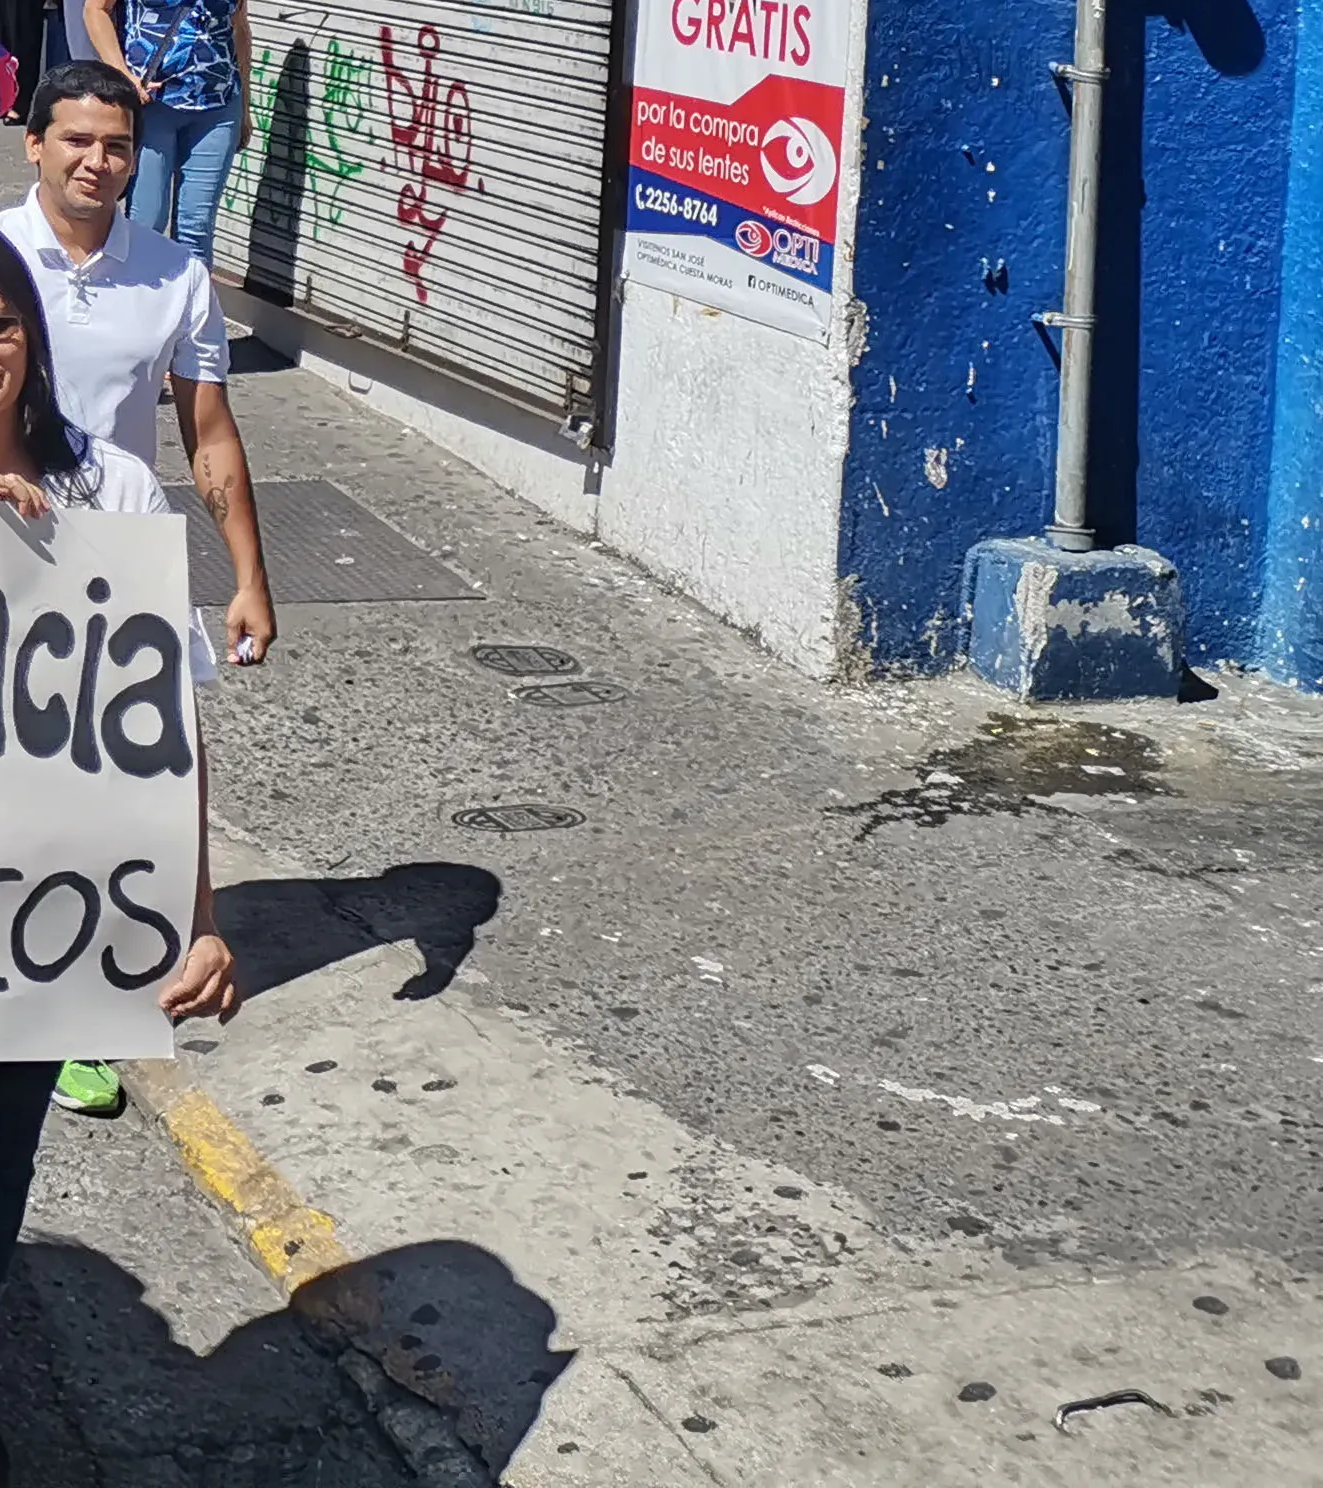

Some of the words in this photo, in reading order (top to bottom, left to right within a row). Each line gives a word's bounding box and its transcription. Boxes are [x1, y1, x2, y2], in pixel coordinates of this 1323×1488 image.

[637, 101, 667, 126] por
[669, 101, 685, 129] la
[690, 112, 759, 147] compra
[641, 135, 665, 164] de
[668, 147, 695, 172] sus
[698, 146, 750, 186] lentes
[645, 187, 718, 227] 2256-8764
[672, 249, 686, 261] SAN
[773, 228, 820, 264] OPTI
[679, 264, 705, 280] CUESTA
[706, 273, 733, 289] MORAS
[758, 280, 815, 307] OPTIMEDICA
